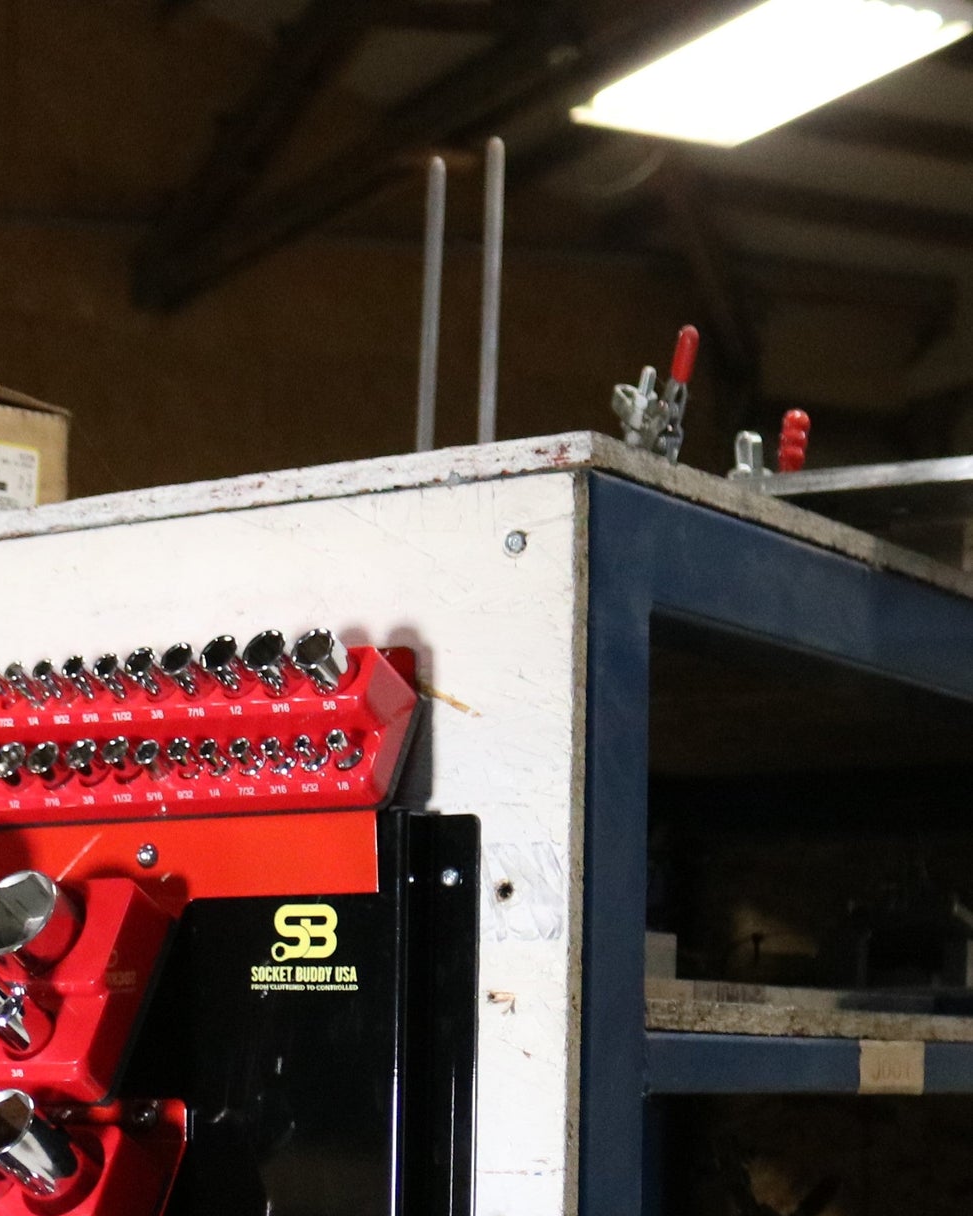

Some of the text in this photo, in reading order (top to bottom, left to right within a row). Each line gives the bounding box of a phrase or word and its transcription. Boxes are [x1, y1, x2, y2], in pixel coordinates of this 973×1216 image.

[27, 716, 39, 725] 1/4
[82, 713, 99, 723] 5/16
[112, 711, 132, 721] 11/32
[151, 710, 164, 719] 3/8
[187, 707, 205, 717] 7/16
[229, 705, 242, 715] 1/2
[272, 703, 290, 713] 9/16
[323, 700, 336, 710] 5/8
[9, 800, 20, 809] 1/2
[82, 795, 94, 804] 3/8
[113, 793, 132, 803] 11/32
[146, 792, 163, 801] 5/16
[177, 790, 193, 799] 9/32
[209, 788, 220, 797] 1/4
[238, 786, 255, 795] 7/32
[270, 785, 287, 794] 3/16
[301, 783, 319, 792] 5/32
[337, 781, 349, 790] 1/8
[271, 904, 338, 962] SB
[251, 966, 358, 982] SOCKET BUDDY USA
[11, 1069, 23, 1077] 3/8
